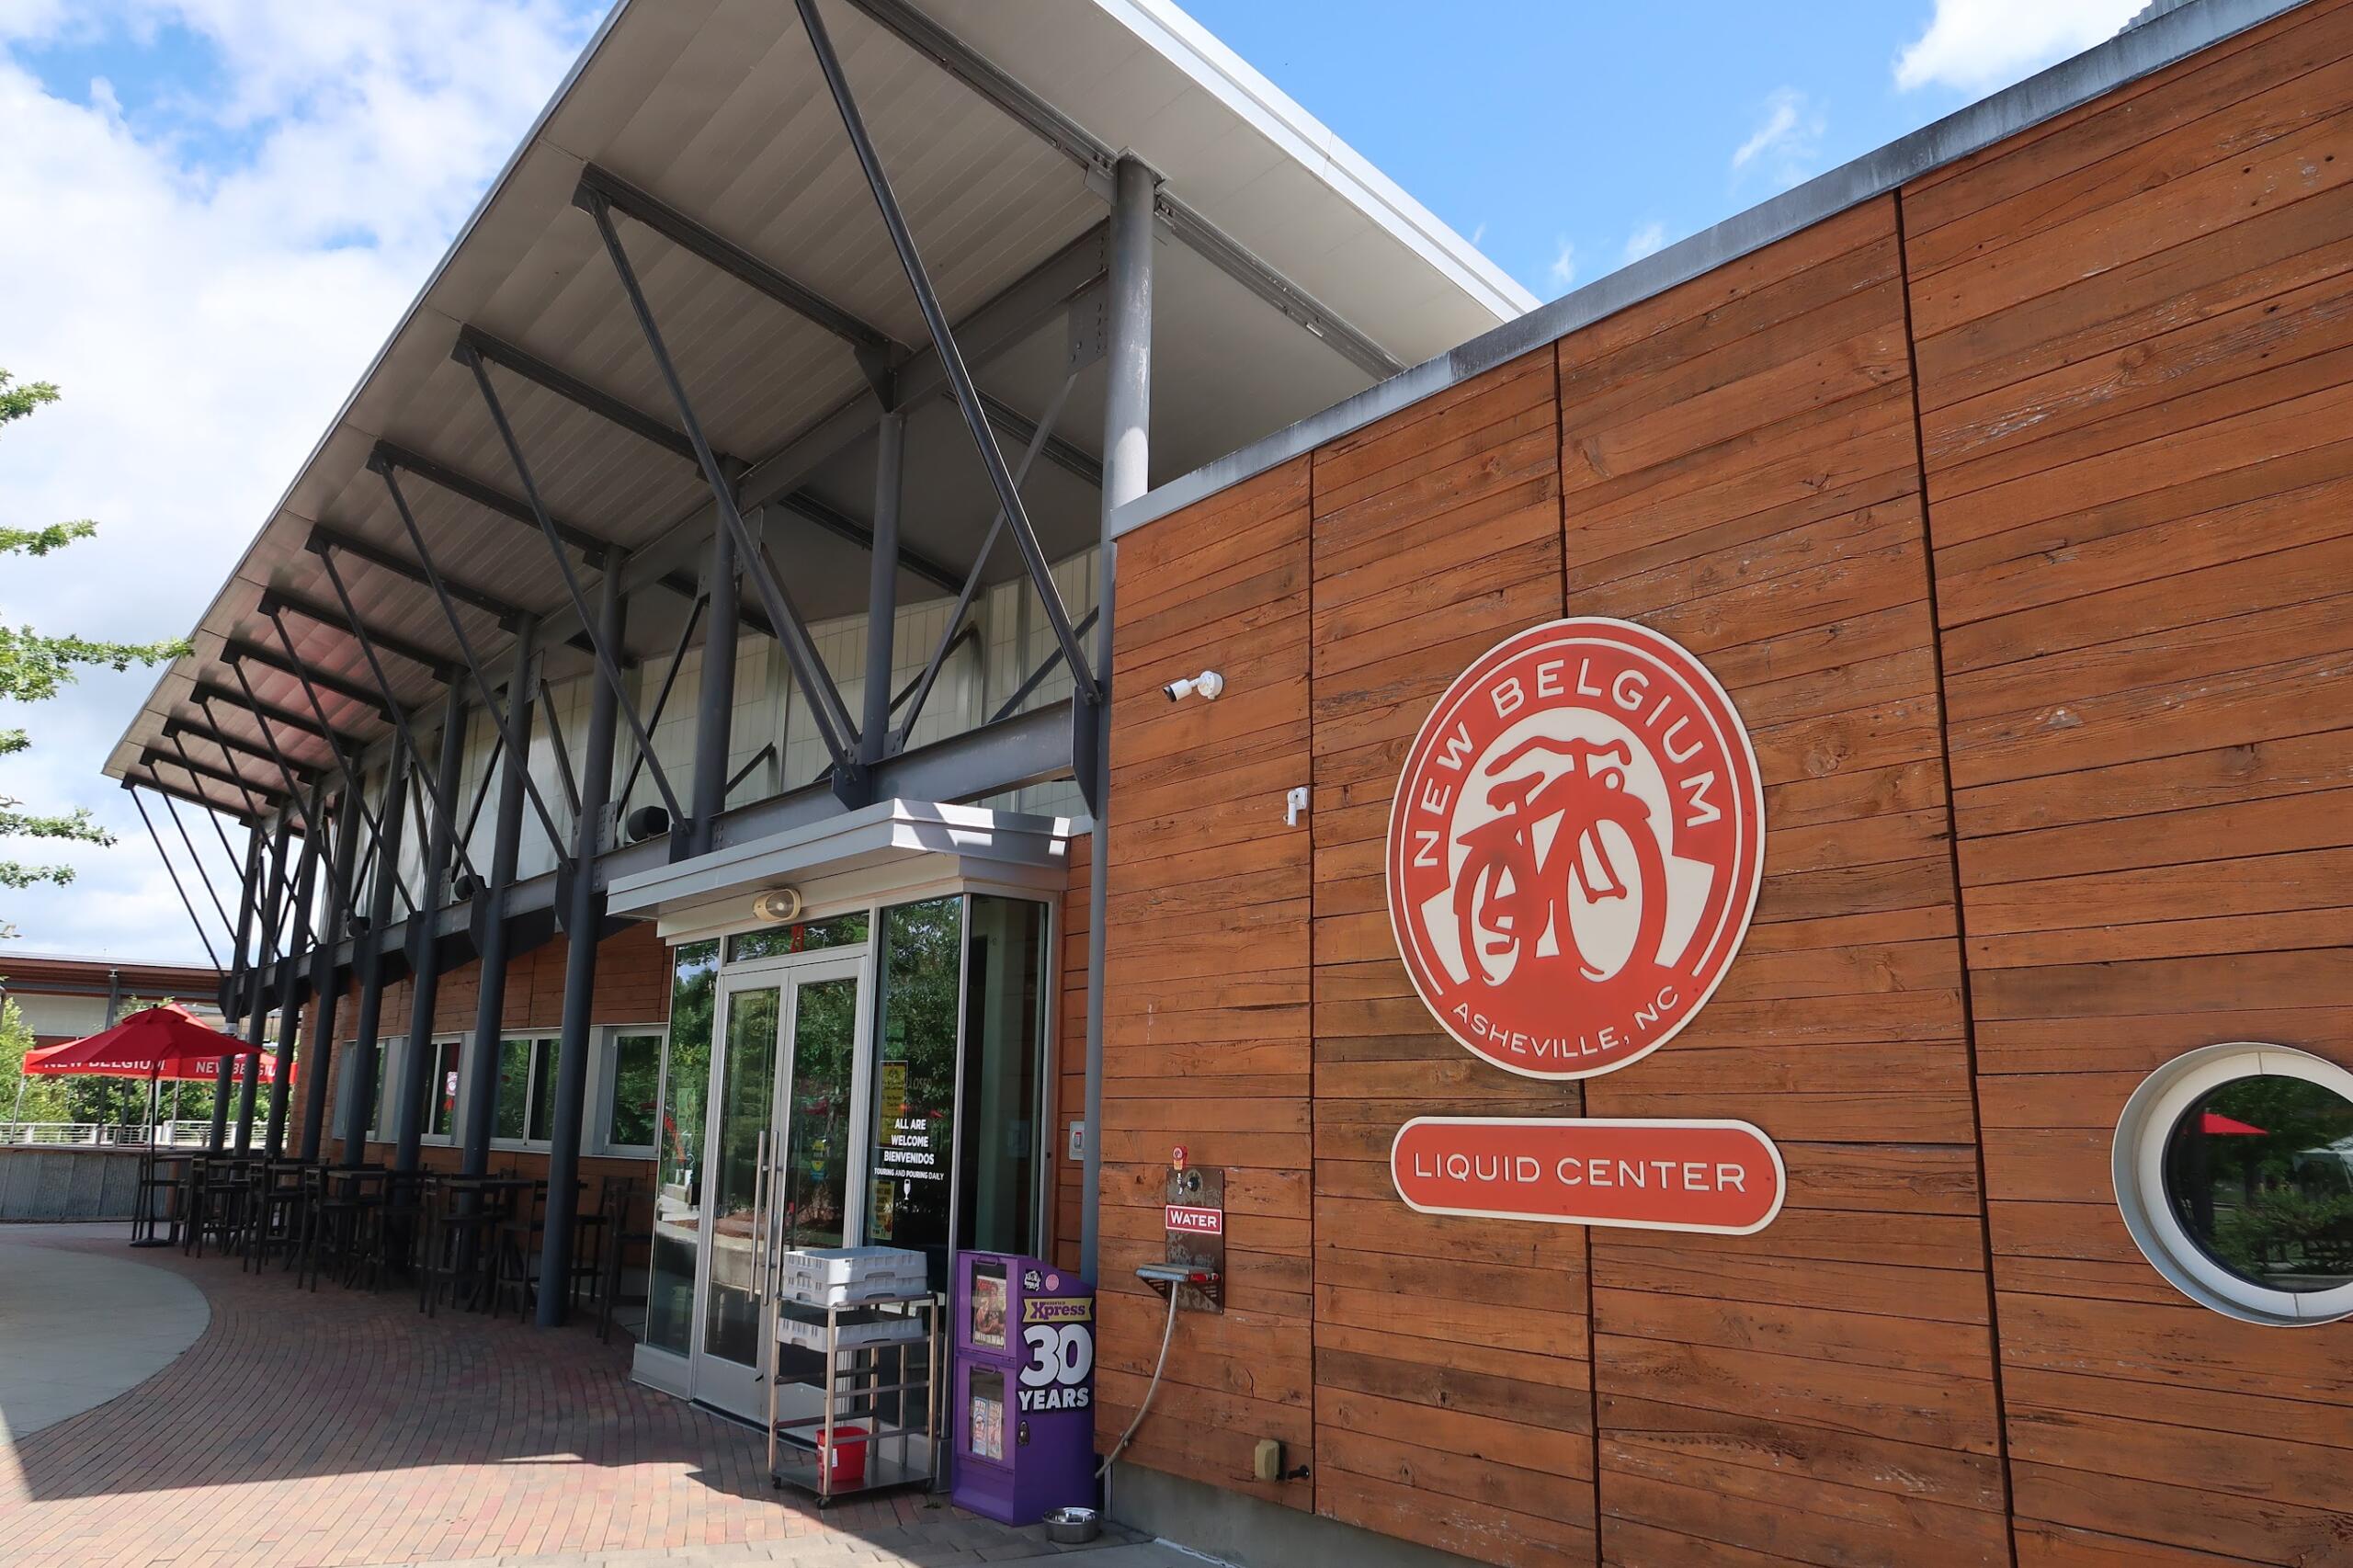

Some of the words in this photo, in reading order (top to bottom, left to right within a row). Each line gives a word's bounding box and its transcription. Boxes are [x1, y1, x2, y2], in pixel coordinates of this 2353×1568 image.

[1413, 721, 1473, 867] NEW
[1490, 658, 1722, 827] BELGIUM
[1452, 1002, 1630, 1058] ASHEVILLE,
[1633, 986, 1678, 1030] NC
[894, 1118, 909, 1130] ALL
[910, 1119, 926, 1130] ARE
[891, 1134, 929, 1147] WELCOME
[883, 1151, 935, 1165] BIENVENIDOS
[874, 1167, 895, 1176] TOURING
[895, 1169, 906, 1177] AND
[905, 1170, 928, 1179] POURING
[928, 1172, 945, 1180] DAILY
[1414, 1153, 1541, 1183] LIQUID
[1555, 1157, 1746, 1193] CENTER
[1170, 1210, 1217, 1228] WATER
[1029, 1301, 1086, 1321] Xpress
[1019, 1324, 1093, 1387] 30
[1017, 1387, 1089, 1411] YEARS
